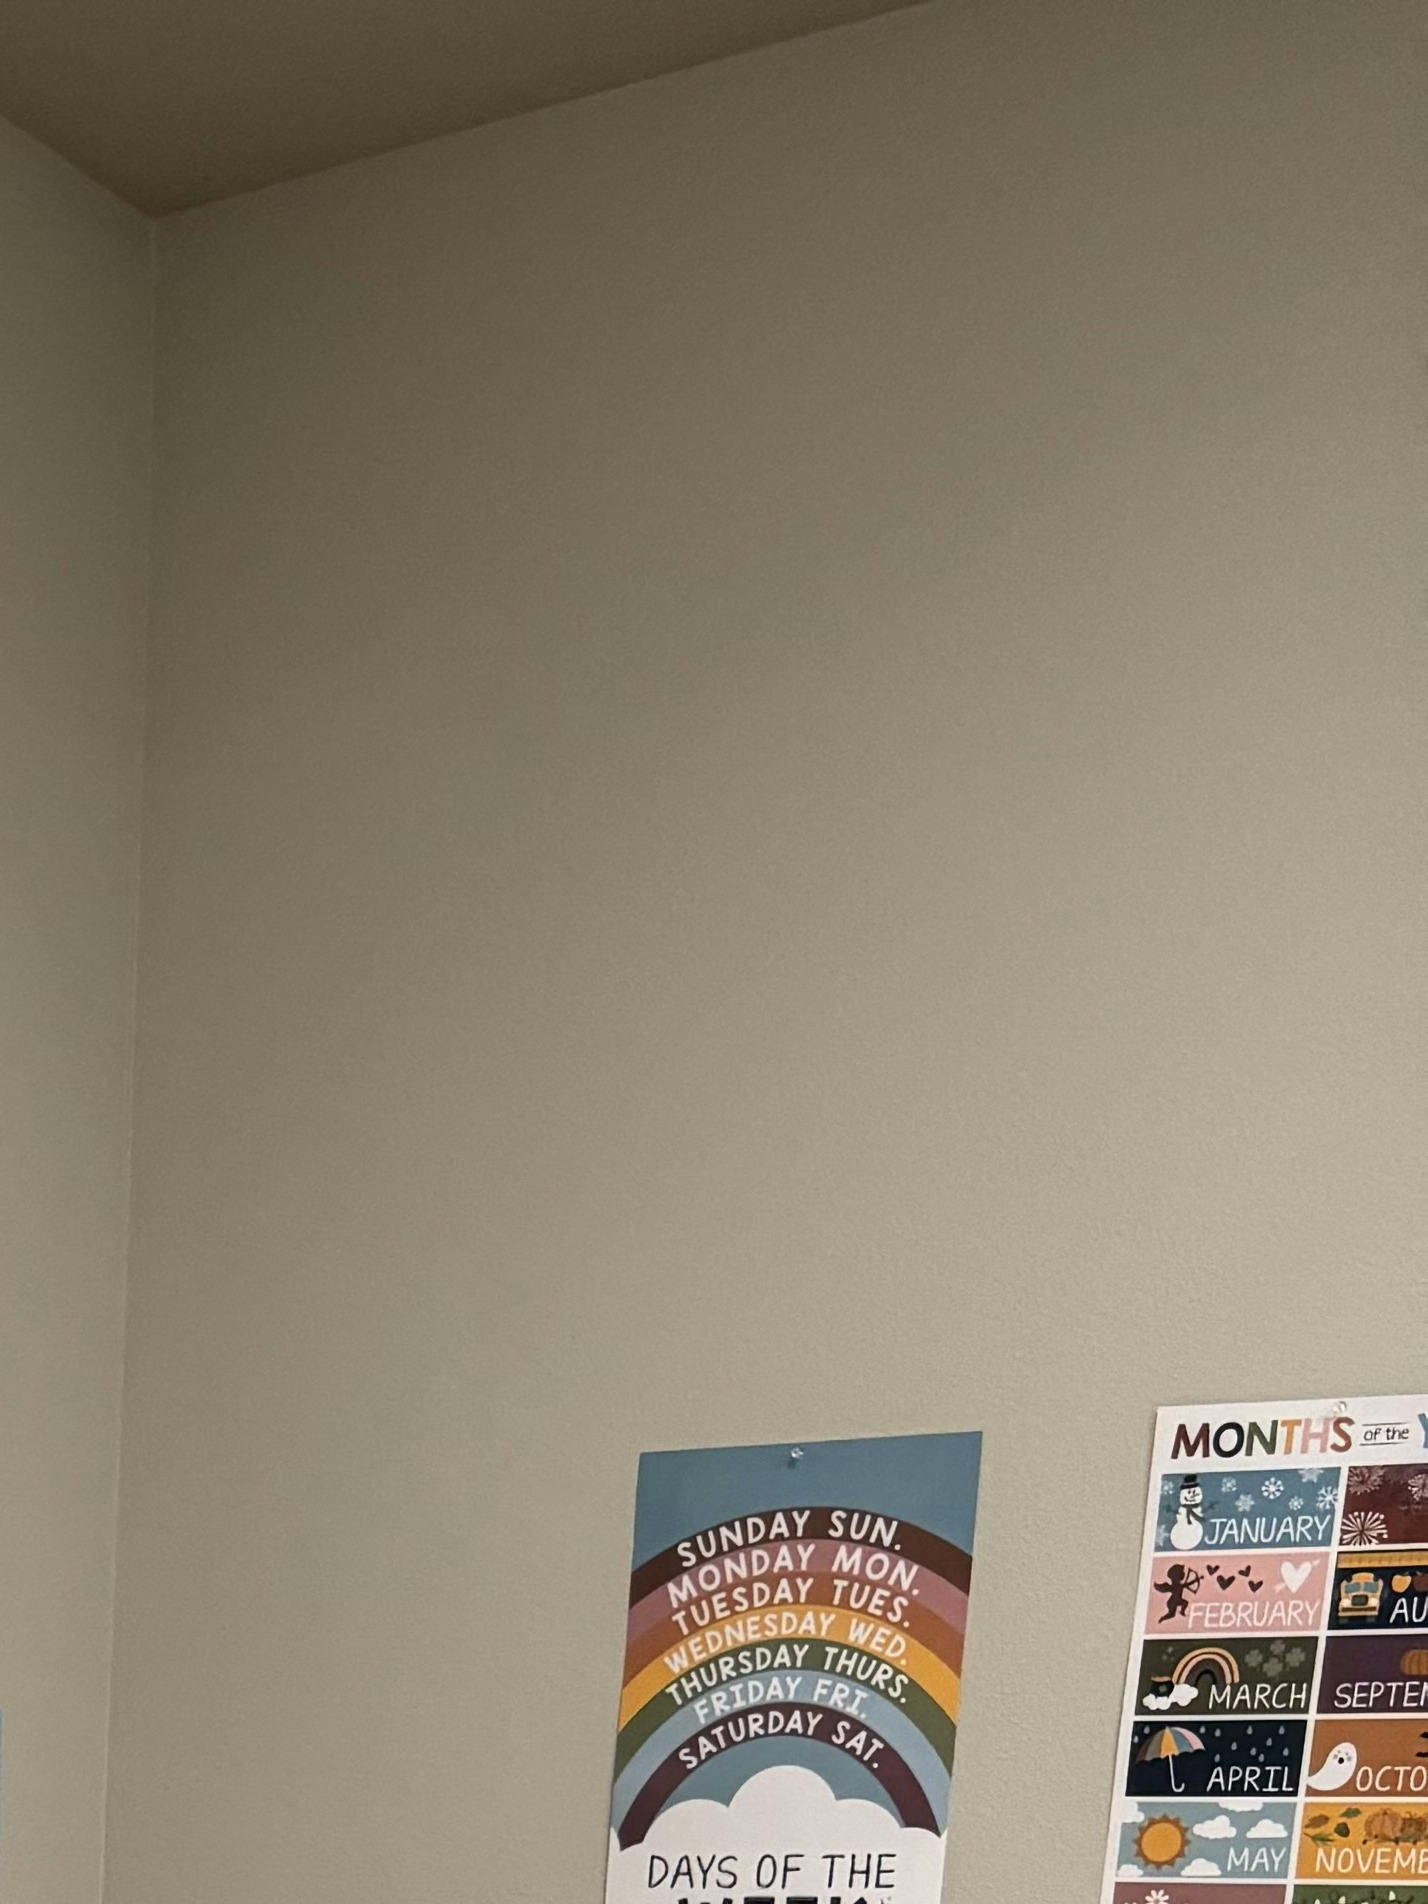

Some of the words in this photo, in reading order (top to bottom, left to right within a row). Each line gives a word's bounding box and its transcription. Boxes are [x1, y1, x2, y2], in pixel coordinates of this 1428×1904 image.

[1171, 1416, 1355, 1459] MONTHS
[1363, 1425, 1382, 1441] of
[1386, 1424, 1410, 1440] the
[677, 1510, 811, 1568] SUNDAY
[828, 1510, 902, 1552] SUN.
[1204, 1516, 1331, 1544] JANUARY
[667, 1544, 816, 1608] MONDAY
[835, 1548, 920, 1596] MON.
[672, 1578, 815, 1635] TUESDAY
[832, 1579, 910, 1628] TUES.
[1188, 1600, 1321, 1628] FEBRUARY
[663, 1613, 837, 1675] WEDNESDAY
[847, 1623, 907, 1667] WED.
[665, 1644, 811, 1706] THURSDAY
[823, 1646, 907, 1704] THURS.
[1208, 1683, 1308, 1710] MARCH
[692, 1677, 799, 1724] FRIDAY
[813, 1680, 867, 1720] FRI.
[678, 1711, 824, 1770] SATURDAY
[831, 1721, 886, 1770] SAT.
[1206, 1766, 1294, 1792] APRIL
[648, 1853, 739, 1889] DAYS
[756, 1853, 804, 1888] OF
[822, 1853, 897, 1888] THE
[1227, 1848, 1286, 1872] MAY
